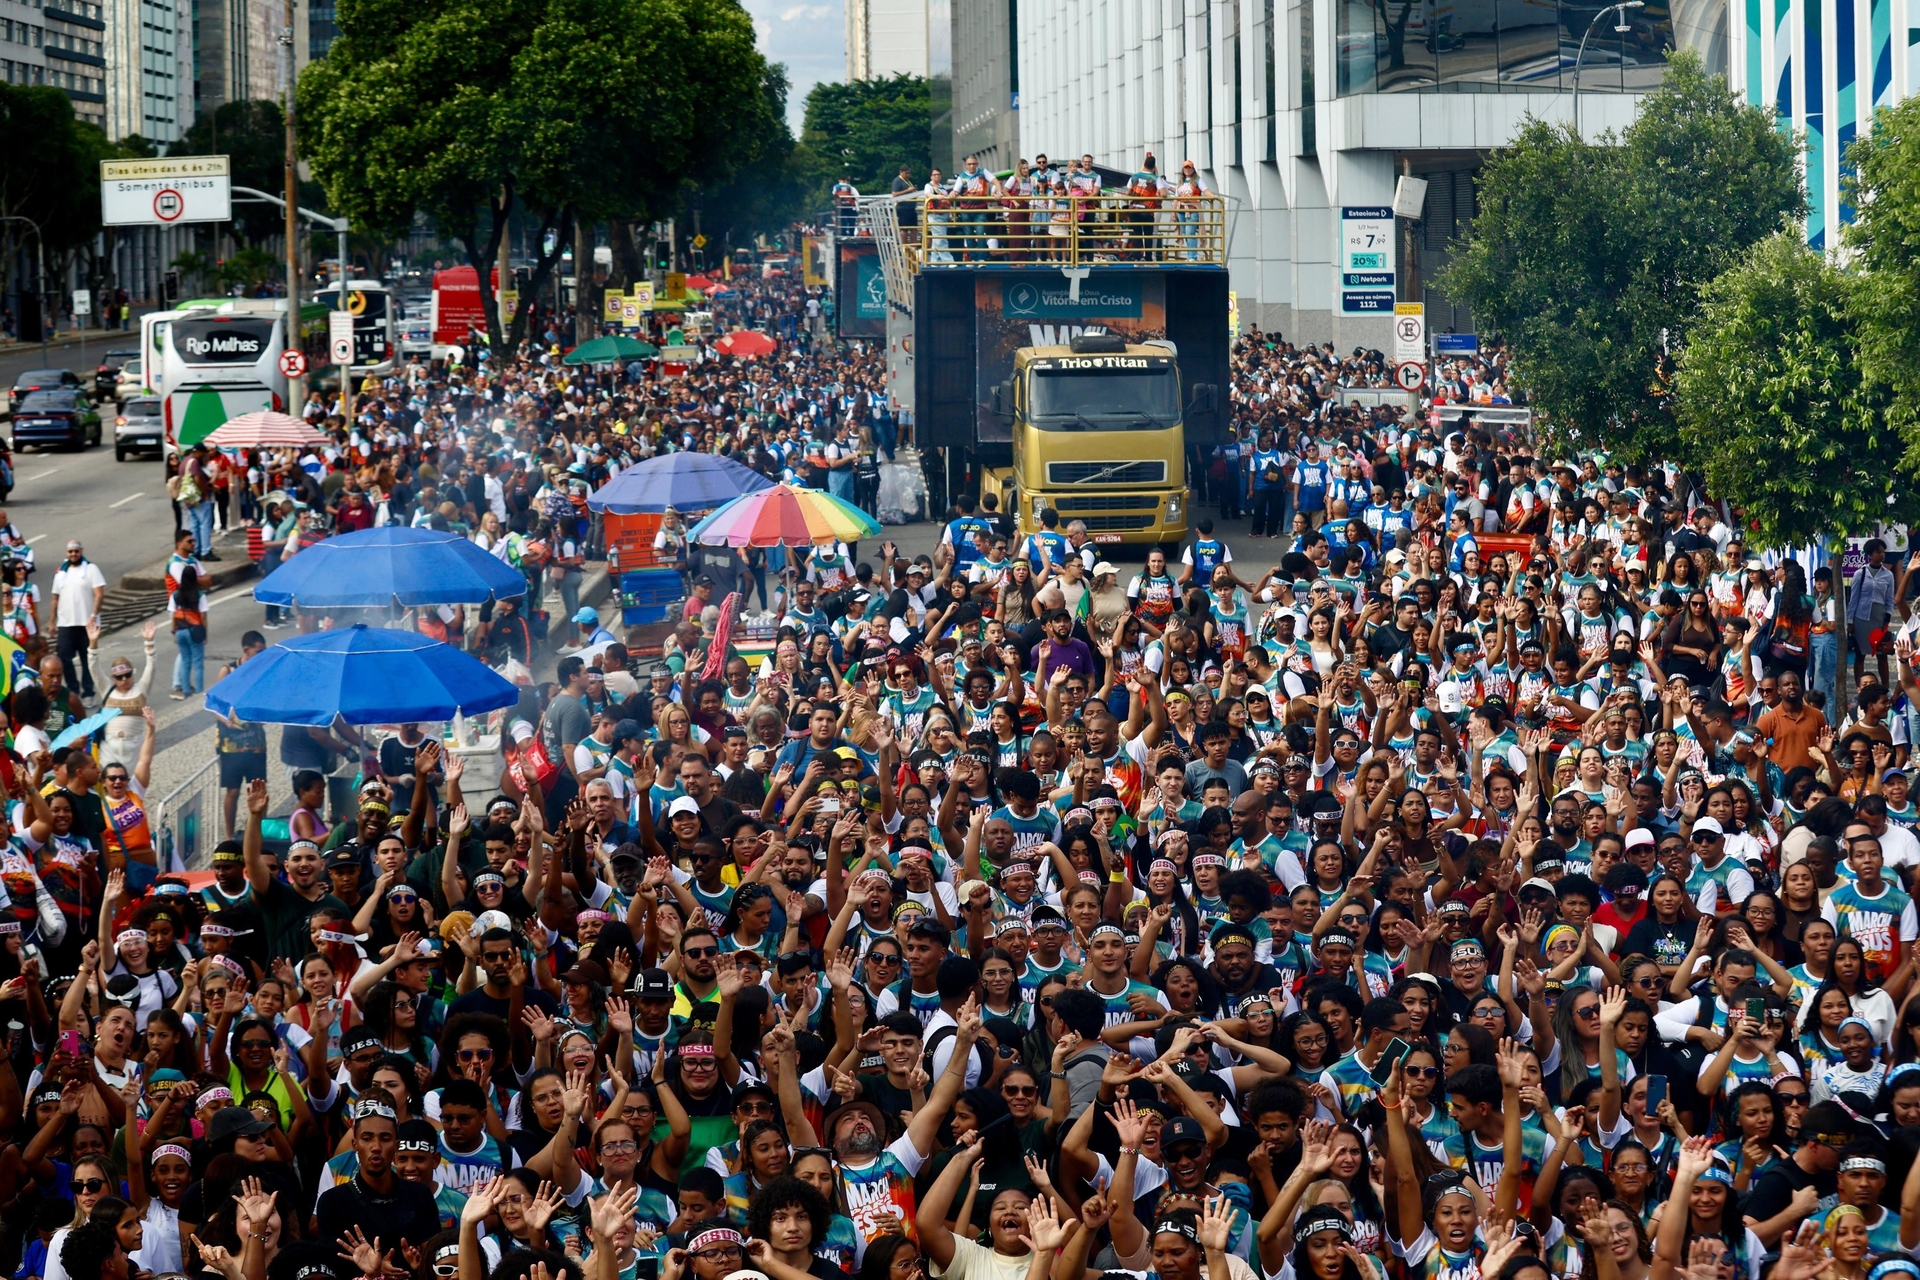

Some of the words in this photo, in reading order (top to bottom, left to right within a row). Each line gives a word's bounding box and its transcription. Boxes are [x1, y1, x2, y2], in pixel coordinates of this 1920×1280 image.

[107, 167, 129, 175] Dias
[132, 165, 157, 174] úteis
[160, 165, 177, 173] das
[181, 164, 188, 172] 6
[192, 164, 202, 172] às
[207, 163, 223, 171] 21h
[118, 182, 170, 192] Somente
[174, 180, 215, 189] ônibus
[1353, 257, 1377, 265] 20%
[1081, 297, 1098, 305] em
[1100, 294, 1132, 306] Cristo
[186, 337, 211, 355] Rio
[212, 336, 259, 352] Milhas
[1058, 358, 1092, 369] Trio
[1103, 356, 1149, 368] Titan
[918, 759, 946, 771] JESU
[1847, 910, 1893, 932] MARCHA
[1227, 935, 1244, 944] JESUS
[1328, 934, 1346, 944] JESUS
[1857, 932, 1893, 952] ESUS
[1657, 941, 1685, 953] FARM
[1104, 1011, 1136, 1029] ARCHA
[351, 1037, 383, 1052] JESU
[679, 1044, 715, 1055] JESU
[159, 1079, 176, 1091] JESU
[44, 1090, 62, 1102] JESU
[398, 1139, 430, 1151] SUS
[436, 1162, 496, 1189] MARCHA
[845, 1175, 891, 1210] MARCHA
[1304, 1217, 1351, 1236] JESU
[692, 1230, 738, 1251] JESUS
